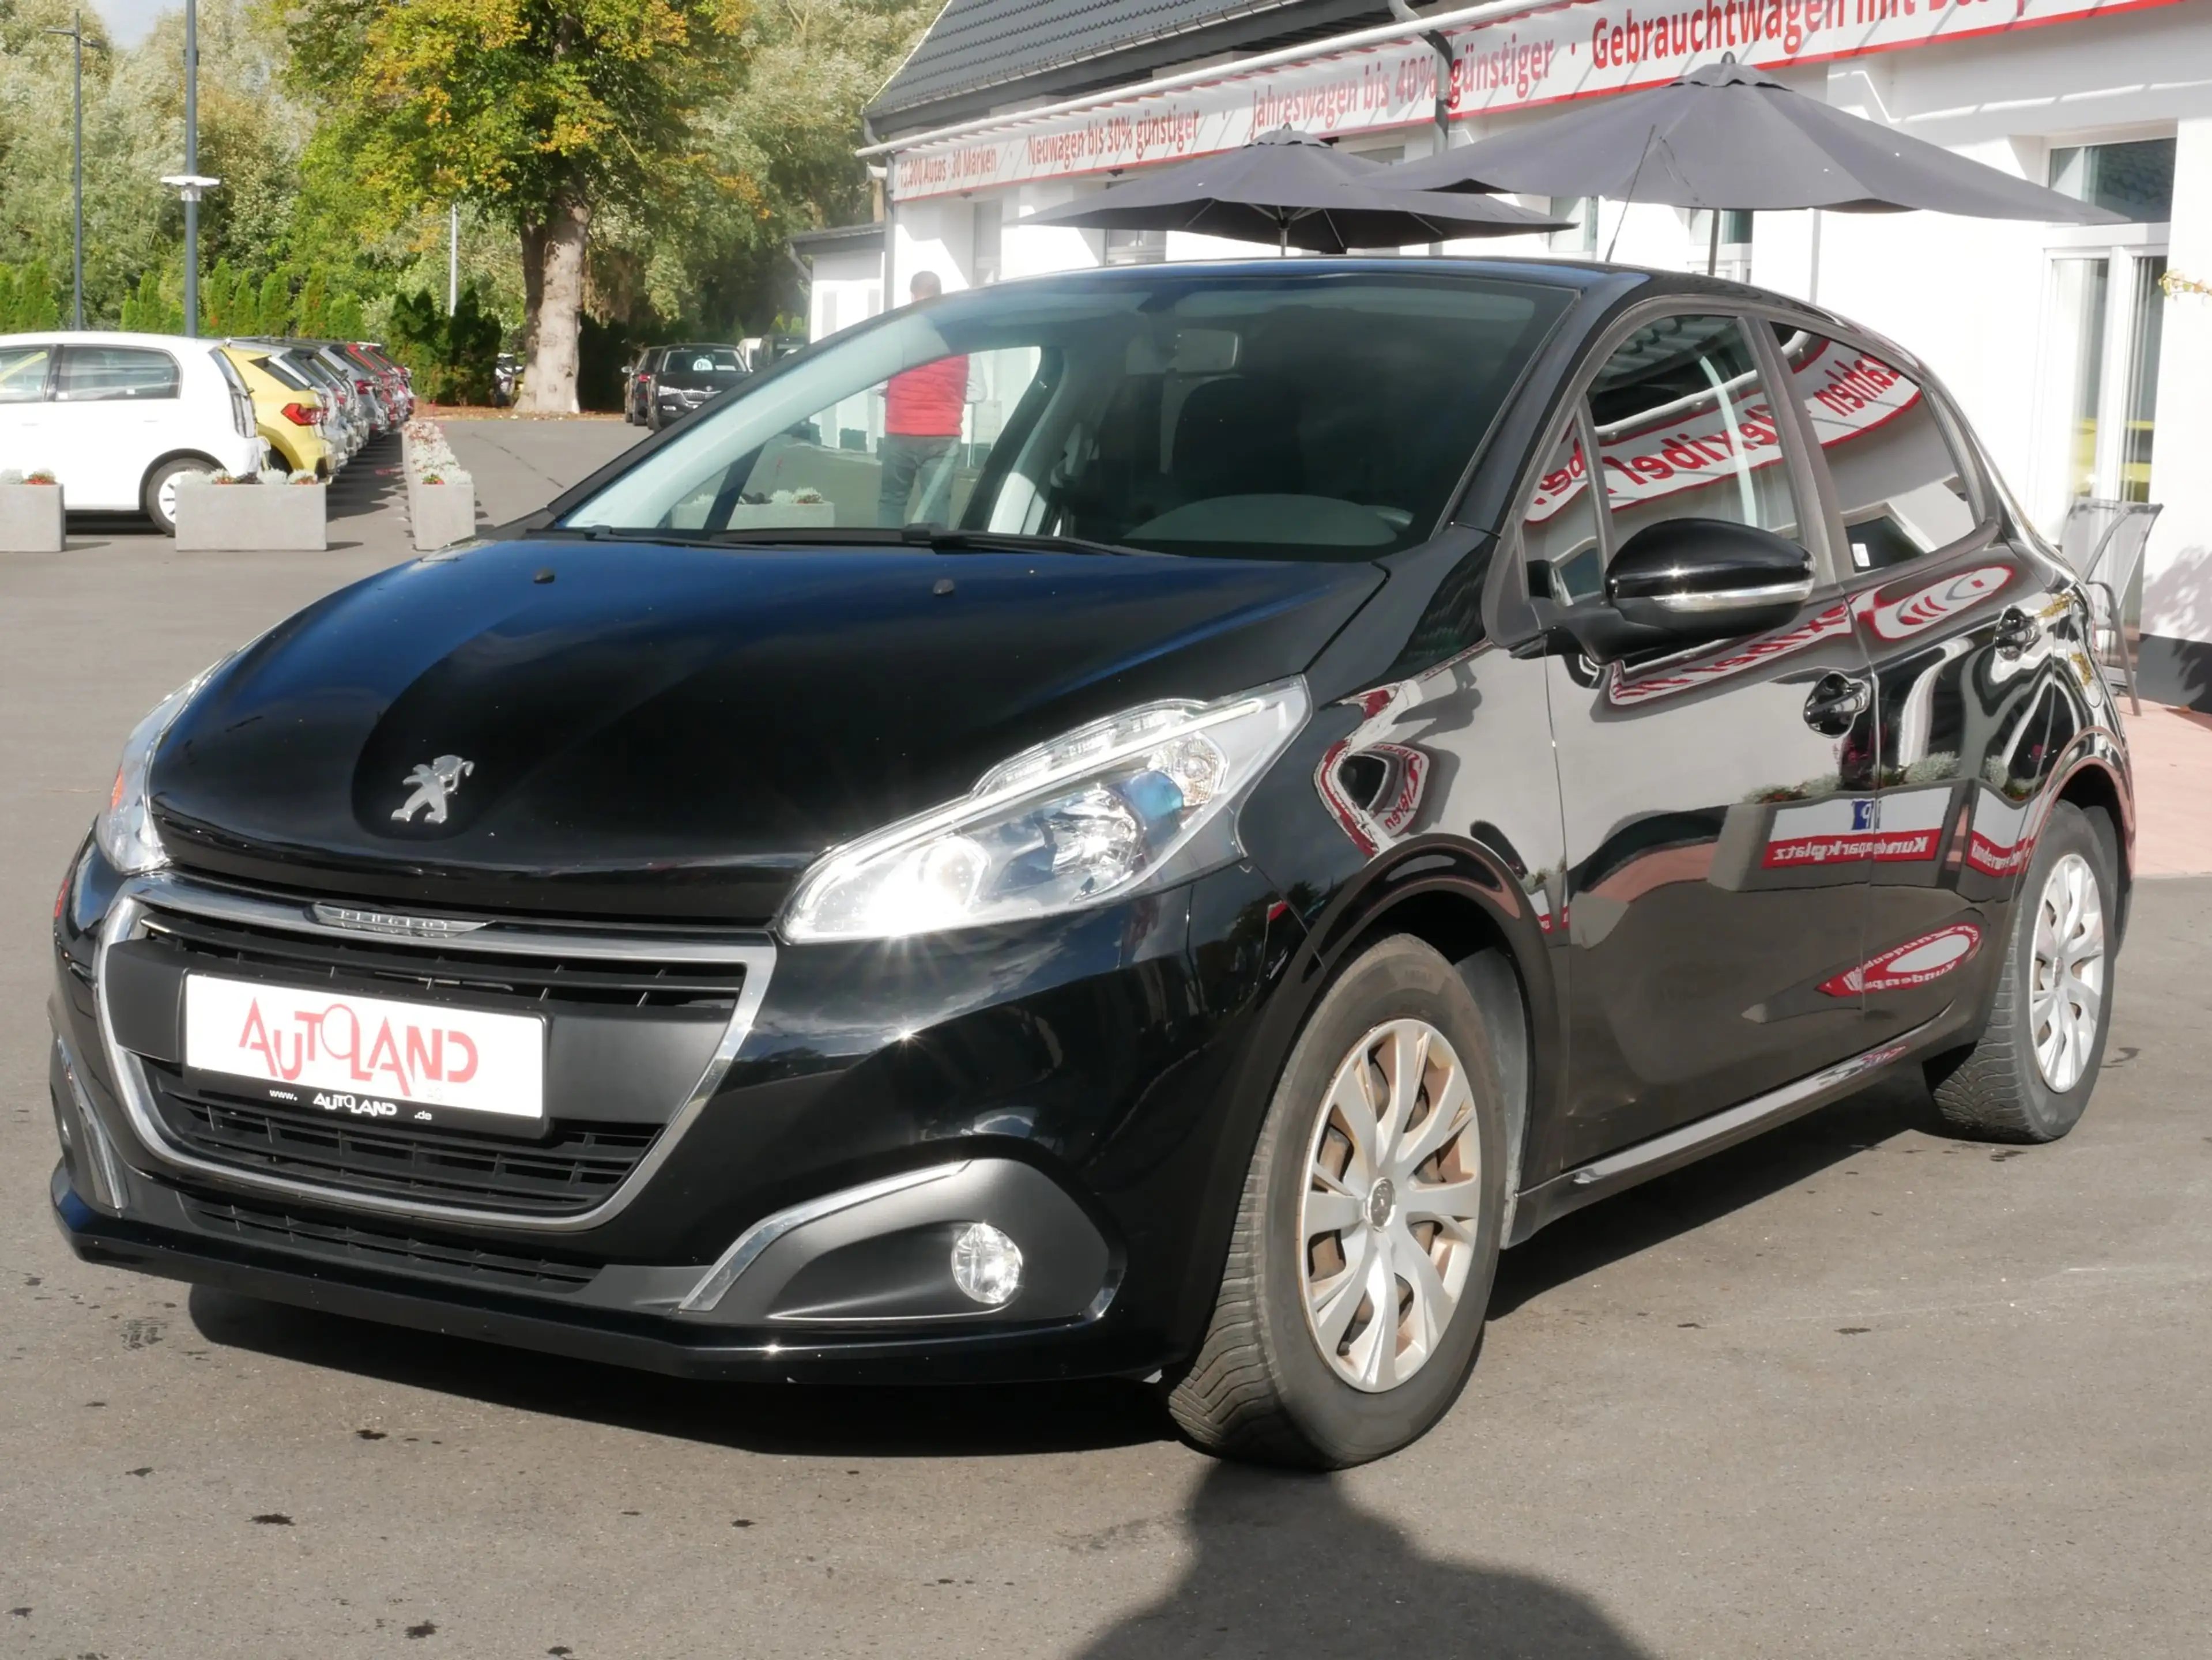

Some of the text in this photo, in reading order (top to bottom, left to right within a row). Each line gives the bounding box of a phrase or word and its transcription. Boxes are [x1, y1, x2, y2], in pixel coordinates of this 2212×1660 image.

[964, 143, 997, 177] Marken
[1027, 132, 1084, 169] Neuwagen
[1087, 120, 1104, 156] bis
[1107, 116, 1132, 152] 30%
[1136, 104, 1200, 160] günstiger
[1249, 79, 1358, 140] Jahreswagen
[1363, 61, 1390, 110] bis
[1395, 55, 1437, 104] 40%
[1449, 33, 1554, 110] günstiger
[1592, 0, 1844, 70] Gebrauchtwagen
[238, 997, 479, 1096] AUTOLAND
[269, 1089, 433, 1121] www. AUTOLAND .de
